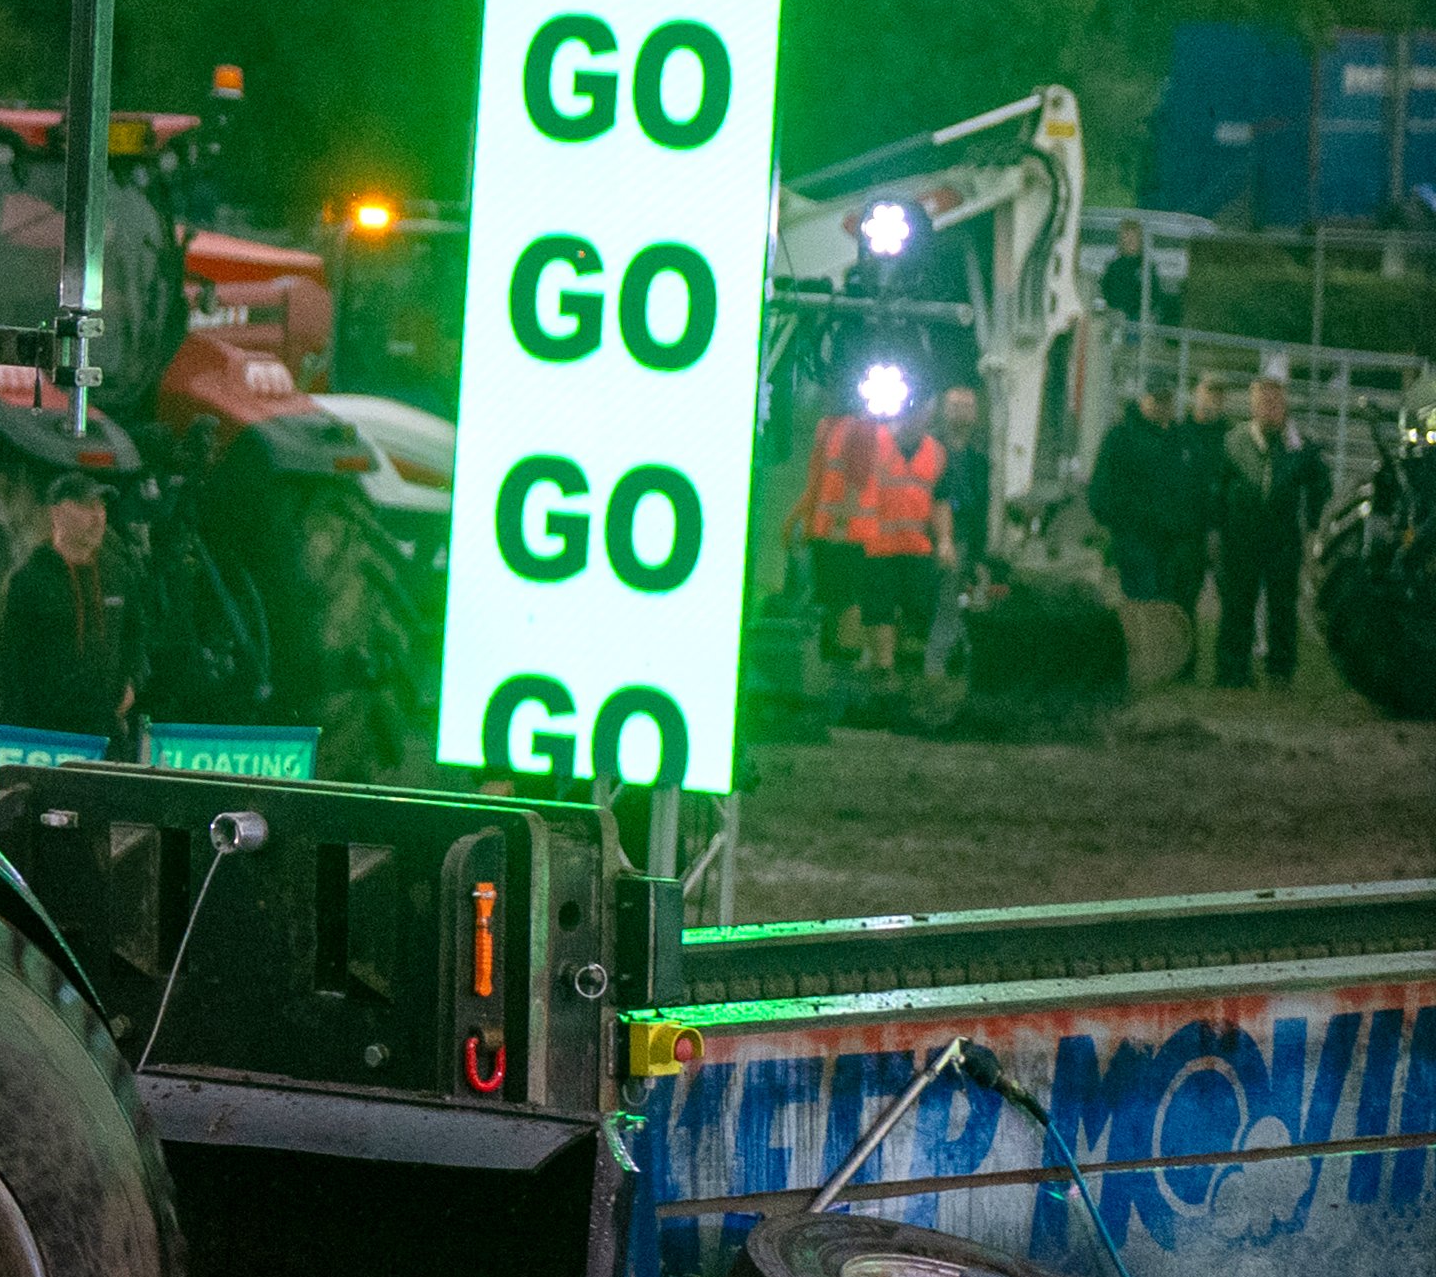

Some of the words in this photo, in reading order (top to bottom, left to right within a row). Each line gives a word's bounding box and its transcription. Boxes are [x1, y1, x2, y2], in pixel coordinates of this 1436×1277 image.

[522, 13, 733, 150] GO
[508, 232, 719, 372] GO
[494, 453, 705, 593] GO
[160, 748, 302, 778] FLOATING
[480, 673, 690, 789] GO
